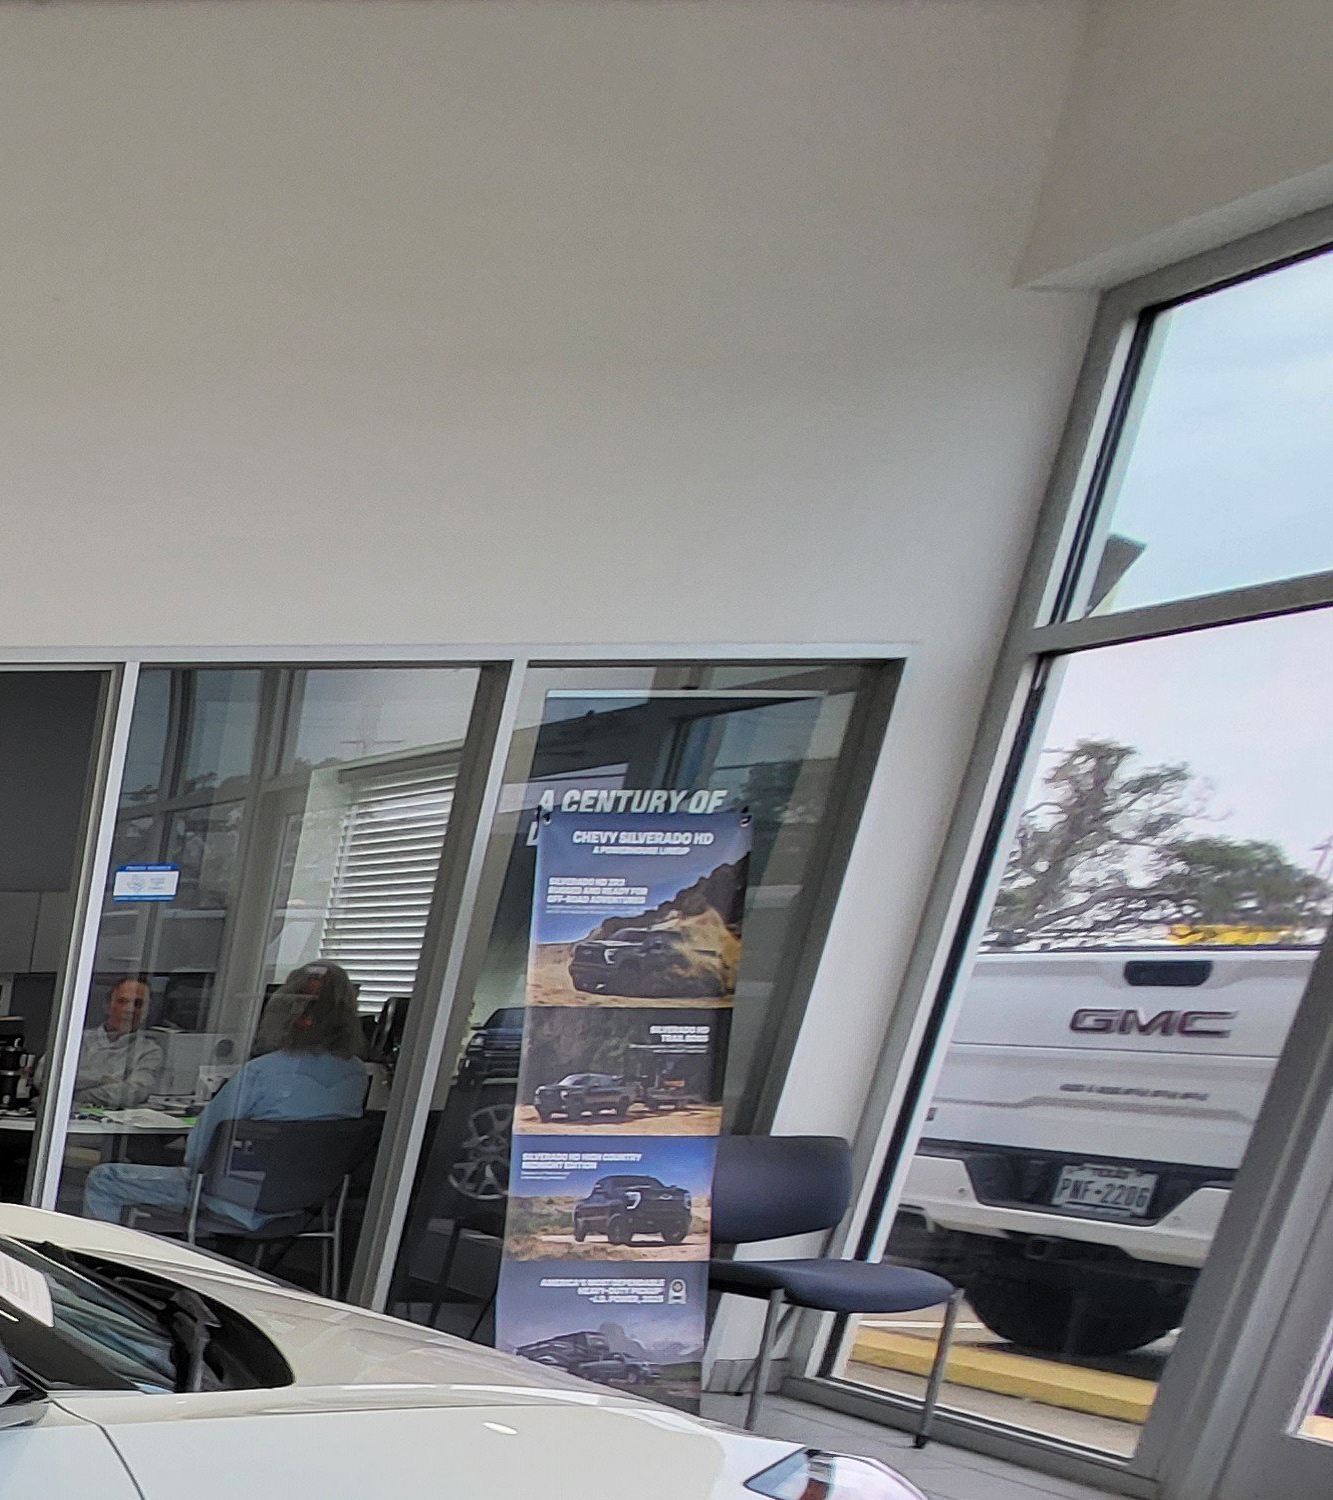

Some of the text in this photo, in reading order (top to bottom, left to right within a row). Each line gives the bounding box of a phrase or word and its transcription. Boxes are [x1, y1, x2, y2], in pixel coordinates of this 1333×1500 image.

[539, 789, 728, 814] A CENTURY OF
[572, 831, 715, 845] CHEVY SILVERADO HD
[1070, 1008, 1238, 1038] GMC
